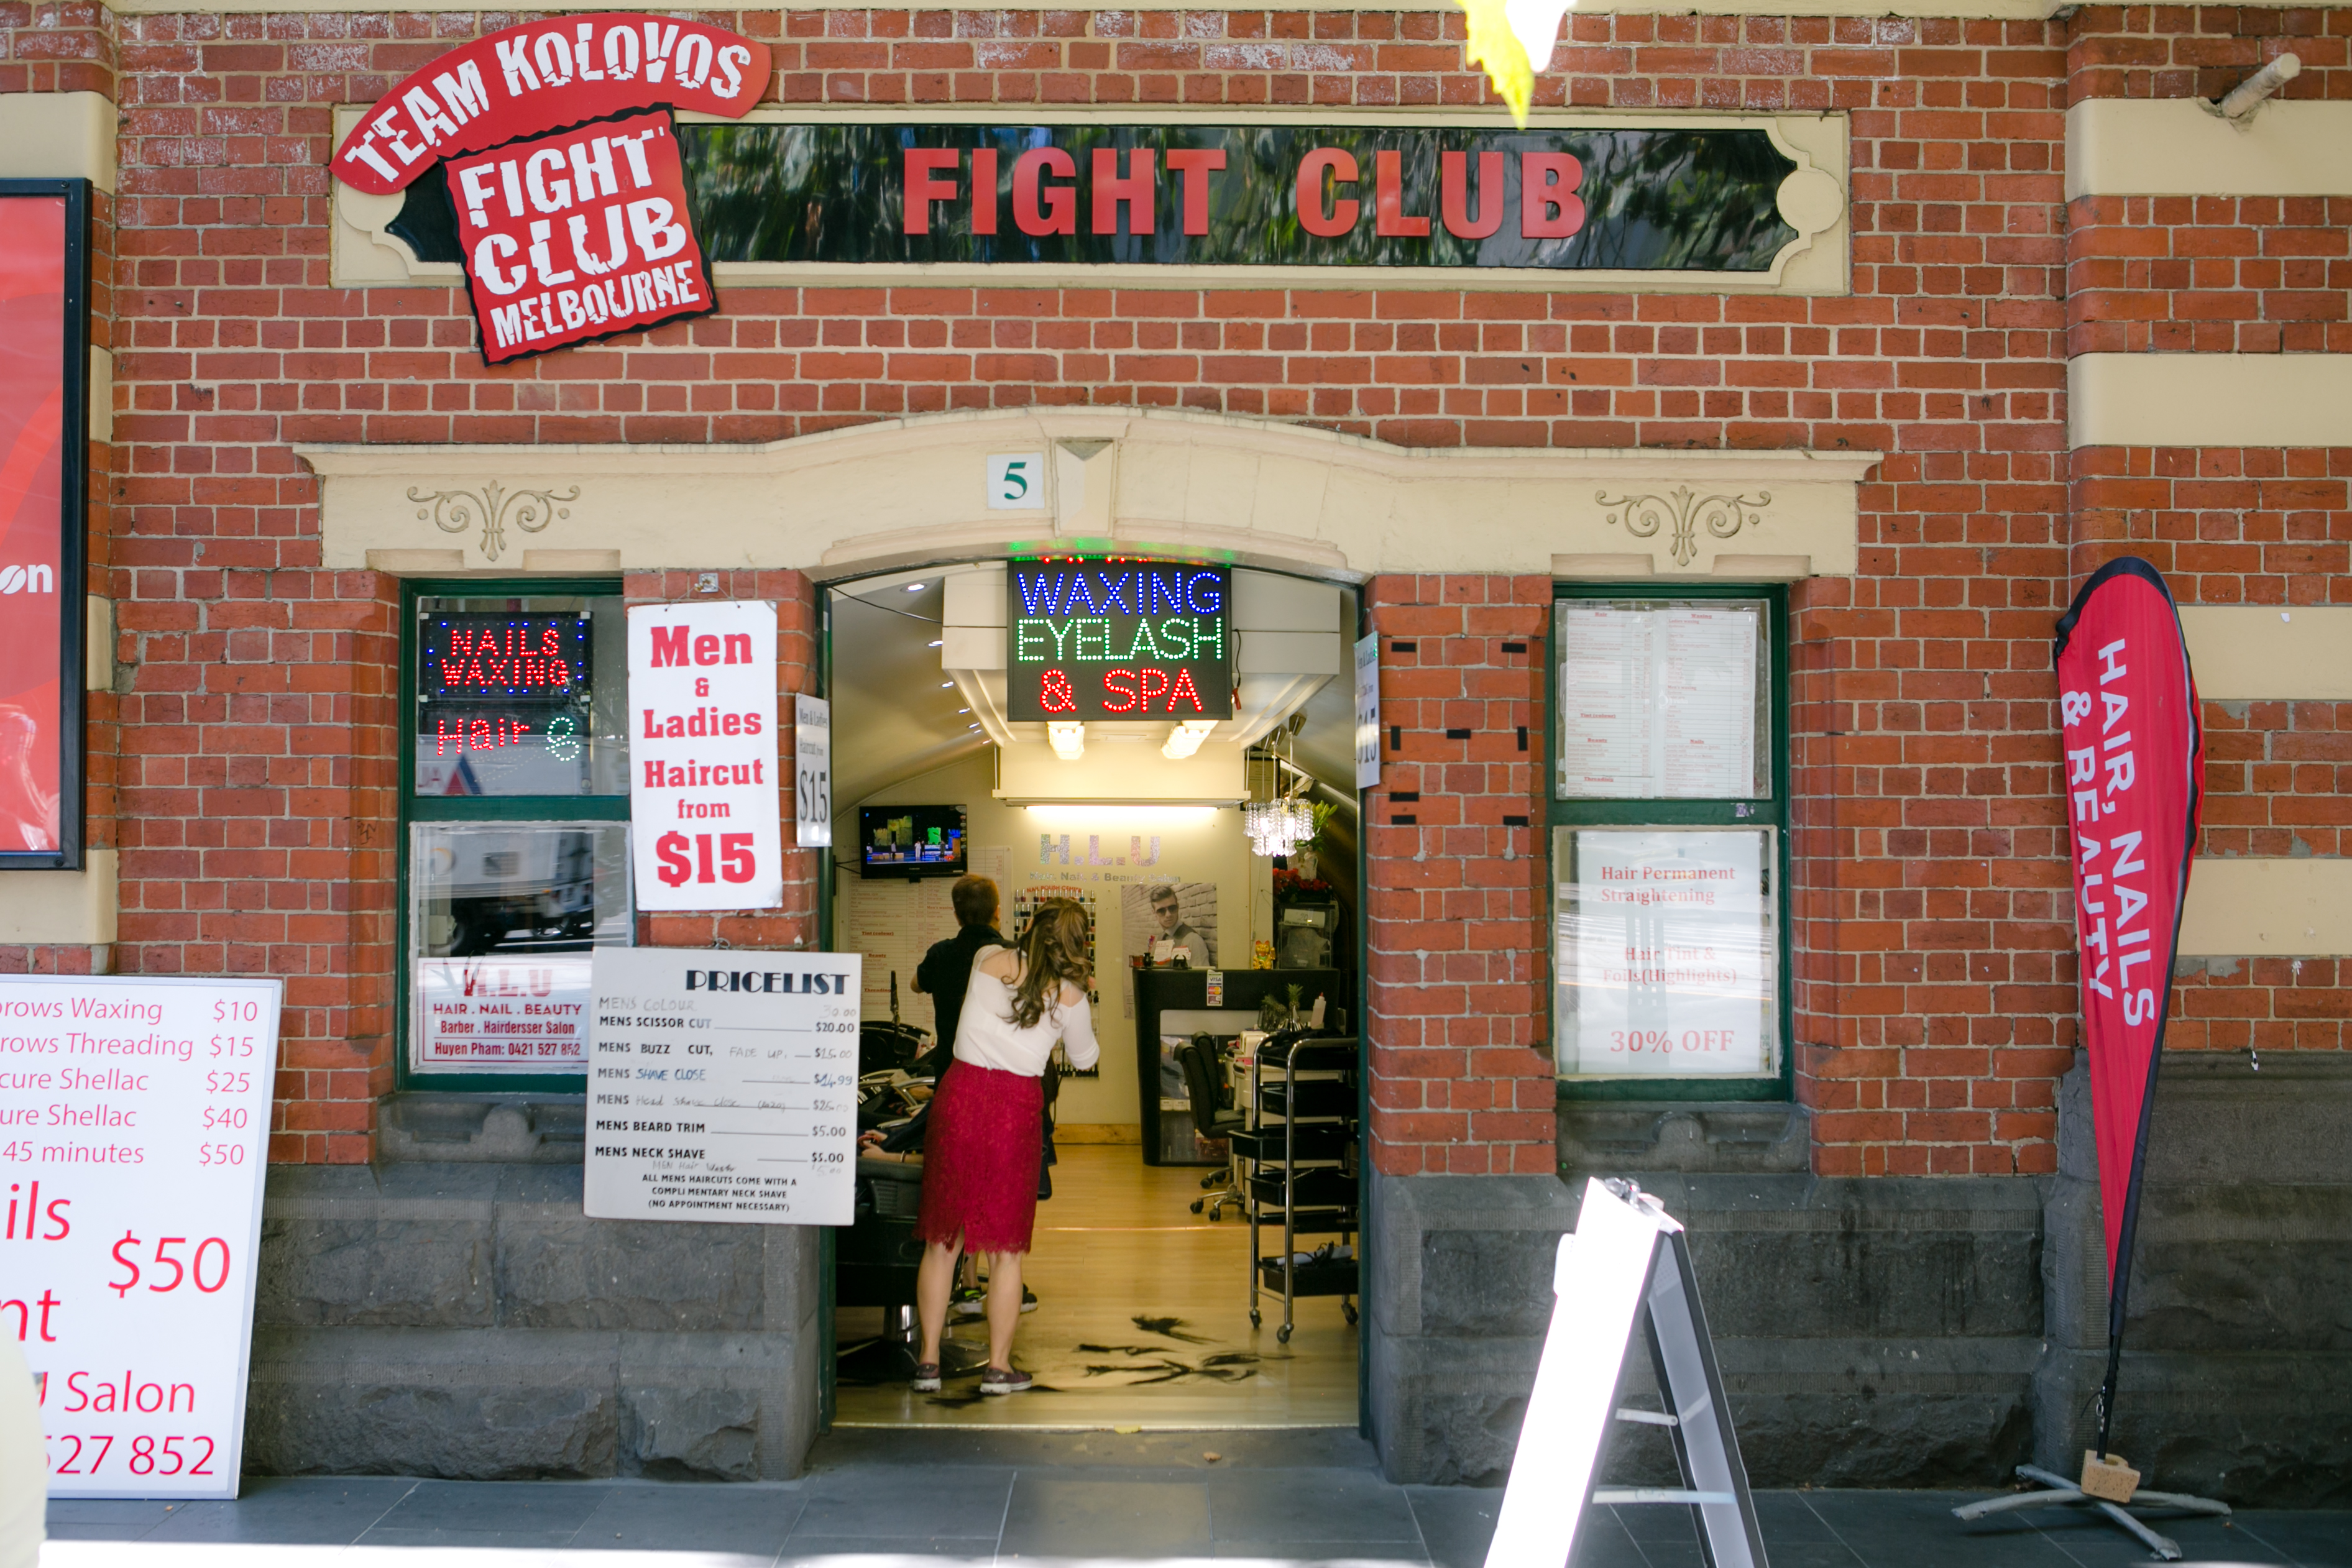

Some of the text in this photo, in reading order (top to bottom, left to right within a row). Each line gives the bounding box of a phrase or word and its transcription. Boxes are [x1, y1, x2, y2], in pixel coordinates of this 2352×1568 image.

[344, 22, 751, 183] TEAM KOLOVOS
[459, 126, 664, 228] FIGHT
[903, 146, 1586, 239] FIGHT CLUB
[474, 197, 686, 295] CLUB
[490, 260, 700, 348] MELBOURNE
[1004, 462, 1027, 500] 5
[1017, 572, 1221, 615] WAXING
[451, 629, 559, 657] NAILS
[650, 625, 753, 668] Men
[1018, 618, 1222, 661] EYELASH
[440, 658, 569, 687] WAXING
[695, 677, 709, 697] &
[1039, 668, 1203, 713] & SPA
[643, 707, 761, 739] Ladies
[2061, 690, 2092, 728] &
[437, 718, 530, 756] Hair
[644, 758, 763, 788] Haircut
[678, 799, 730, 819] from
[799, 764, 827, 827] $15
[2098, 638, 2154, 1027] HAIR, NAILS
[656, 830, 756, 888] $15
[1040, 833, 1160, 867] H.L.U
[1104, 873, 1145, 884] Beauty
[1601, 866, 1736, 880] Hair Permanent
[1601, 889, 1715, 905] Straightening
[1624, 947, 1660, 961] Hair
[686, 970, 850, 995] PRICELIST
[0, 997, 257, 1025] rows Waxing $10
[433, 1004, 582, 1016] HAIR NAIL BEAUTY
[441, 1020, 474, 1034] Barber
[546, 1021, 574, 1034] Salon
[600, 1016, 854, 1033] MENS SCISSOR CUT $20.00
[0, 1032, 254, 1061] rows Threading $15
[435, 1042, 581, 1056] Huyen Pham: 0421 527 852
[599, 1042, 631, 1053] MENS
[641, 1043, 671, 1054] BUZZ
[729, 1047, 757, 1058] FADE
[814, 1048, 852, 1059] $15.00
[1610, 1030, 1735, 1053] 30% OFF
[60, 1068, 149, 1091] Shellac
[206, 1070, 250, 1094] $25
[597, 1068, 853, 1088] MENS SHAVE CLOSE $14.99
[597, 1094, 629, 1105] MENS
[47, 1104, 136, 1127] Shellac
[202, 1106, 247, 1130] $40
[596, 1121, 846, 1137] MENS BEARD TRIM $5.00
[2, 1141, 244, 1167] 45 minutes $50
[595, 1146, 844, 1163] MENS NECK SHAVE $5.00
[642, 1174, 658, 1182] ALL
[661, 1175, 685, 1183] MENS
[689, 1175, 732, 1184] HAIRCUTS
[736, 1176, 761, 1185] COME
[765, 1178, 788, 1186] WITH
[648, 1199, 790, 1213] (NO APPOINTMENT NECESSARY)
[732, 1190, 756, 1198] NECK
[759, 1190, 787, 1199] SHAVE
[6, 1181, 71, 1240] ils
[108, 1230, 231, 1298] $50
[64, 1370, 195, 1413] Salon
[129, 1435, 214, 1475] 852
